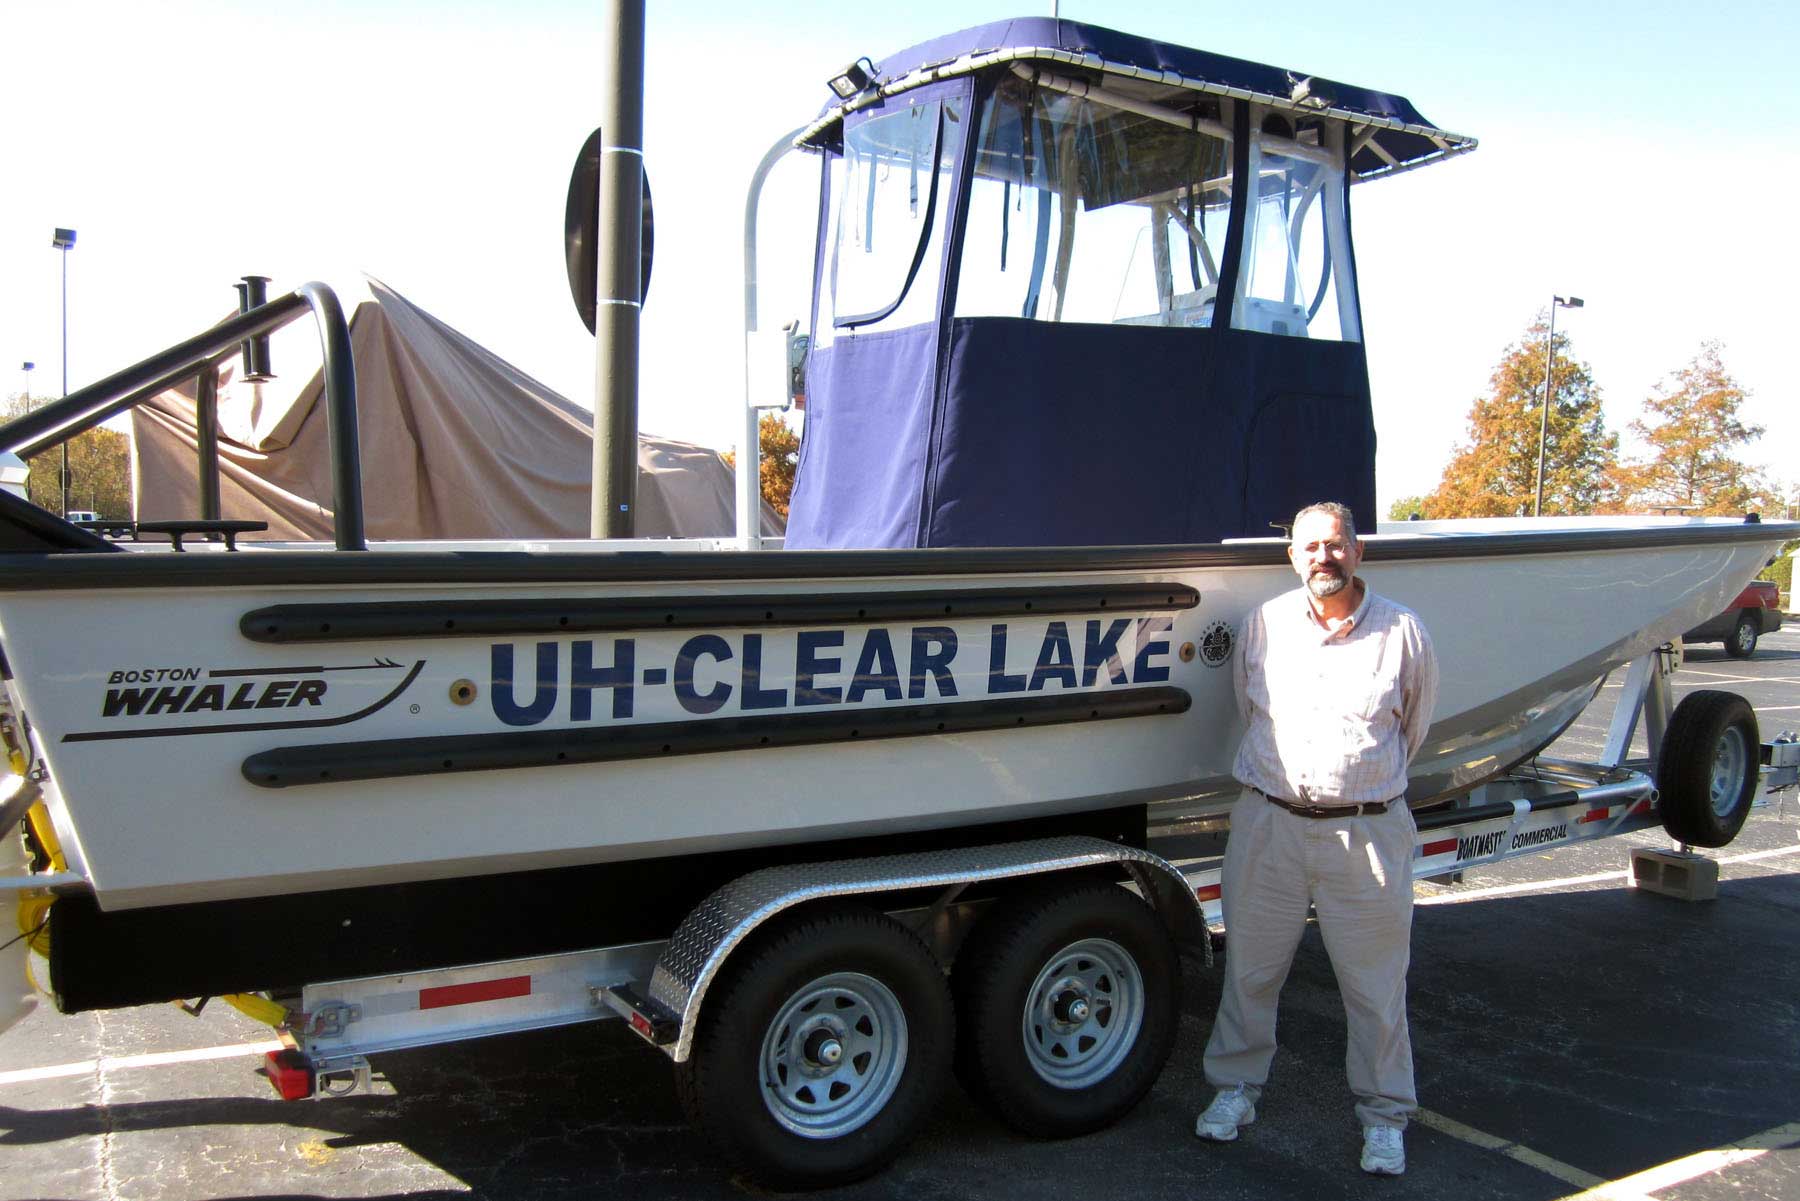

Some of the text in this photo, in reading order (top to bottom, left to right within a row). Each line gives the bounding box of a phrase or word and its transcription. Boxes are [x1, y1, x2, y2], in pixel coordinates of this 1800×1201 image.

[107, 667, 201, 684] BOSTON
[491, 626, 959, 727] UH-CLEAR
[987, 617, 1174, 694] LAKE
[102, 679, 328, 717] WHALER
[1456, 824, 1567, 861] BOATMASTE COMMERCIAL
